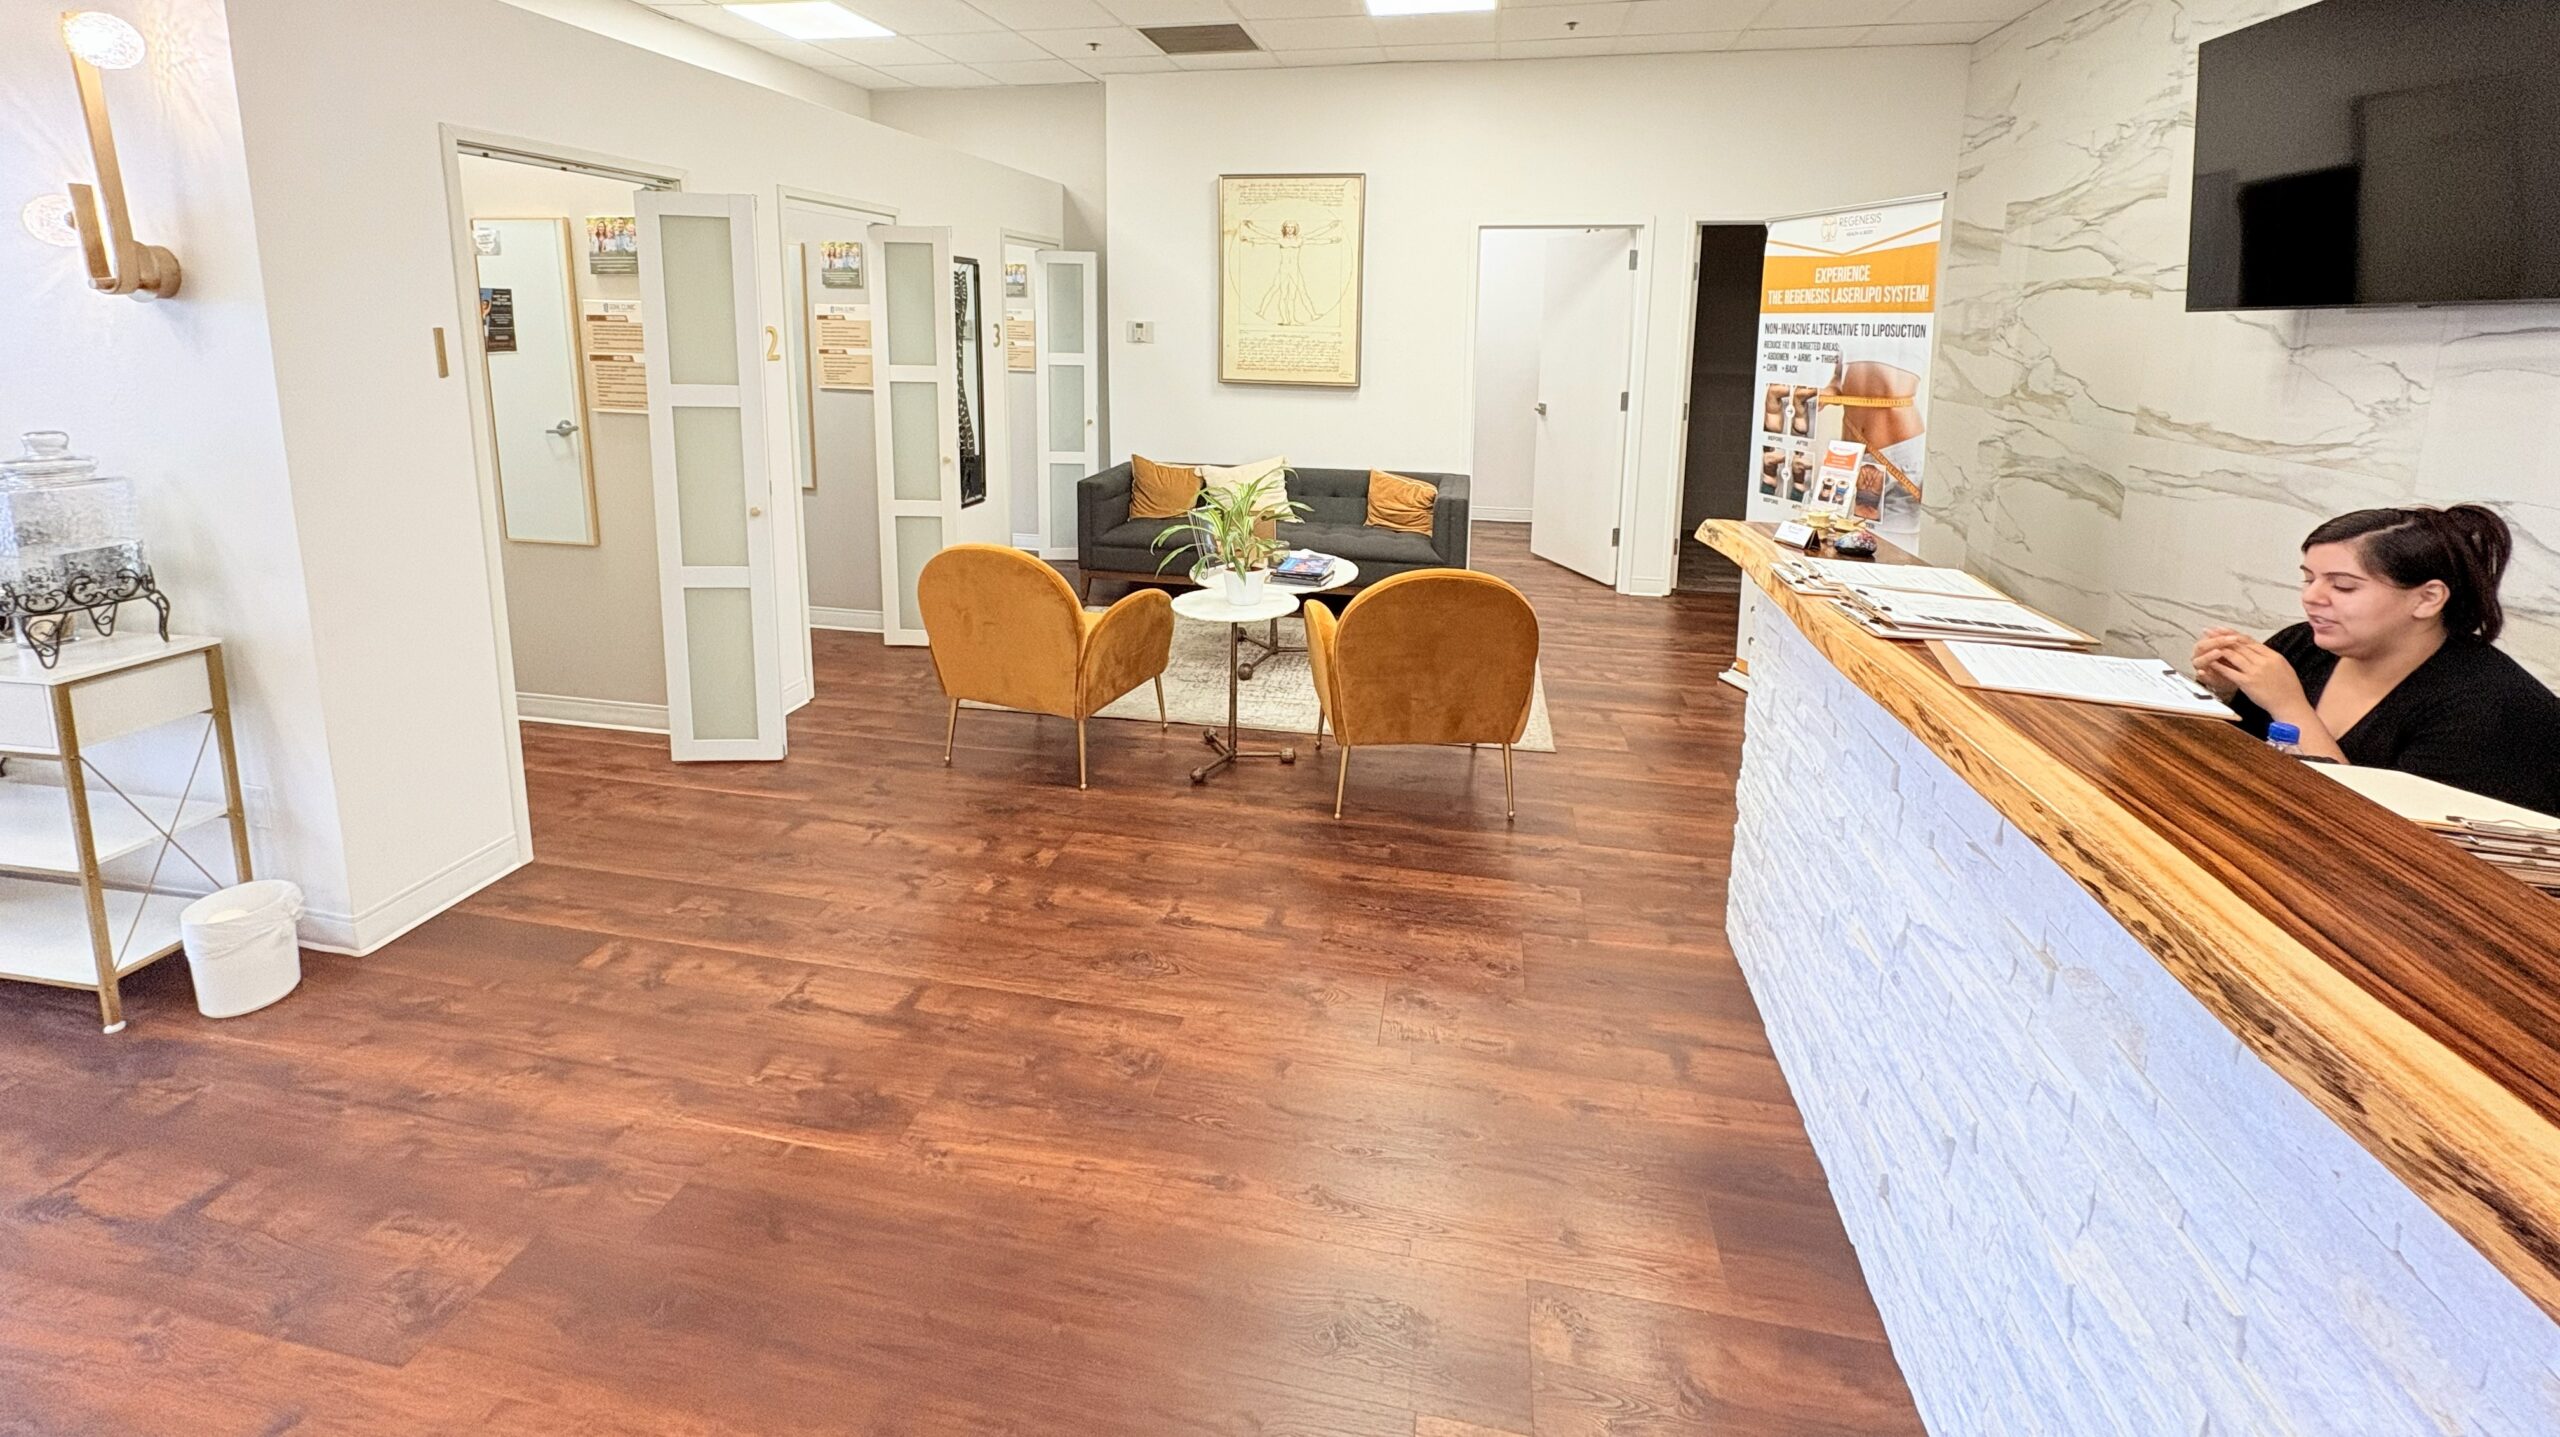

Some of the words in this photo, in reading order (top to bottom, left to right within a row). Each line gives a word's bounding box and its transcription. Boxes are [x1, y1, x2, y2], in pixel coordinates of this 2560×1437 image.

[1839, 212, 1882, 227] REGENESIS
[1815, 265, 1871, 283] EXPERIENCE
[1768, 290, 1783, 305] THE
[1784, 288, 1830, 305] REGENESIS
[1831, 285, 1881, 304] LASERLIPO
[1884, 284, 1930, 303] SYSTEM!
[993, 323, 1001, 348] 3
[1765, 323, 1810, 335] NON-INVASIVE
[1811, 323, 1859, 336] ALTERNATIVE
[1861, 323, 1871, 336] TO
[1872, 323, 1927, 338] LIPOSUCTION
[766, 325, 781, 362] 2
[1764, 340, 1781, 349] REDUCE
[1797, 342, 1820, 351] TARGETED
[1768, 352, 1789, 361] ABDOMEN
[1798, 354, 1811, 362] ARMS
[1766, 363, 1777, 372] CHIN
[1785, 365, 1798, 374] BACK
